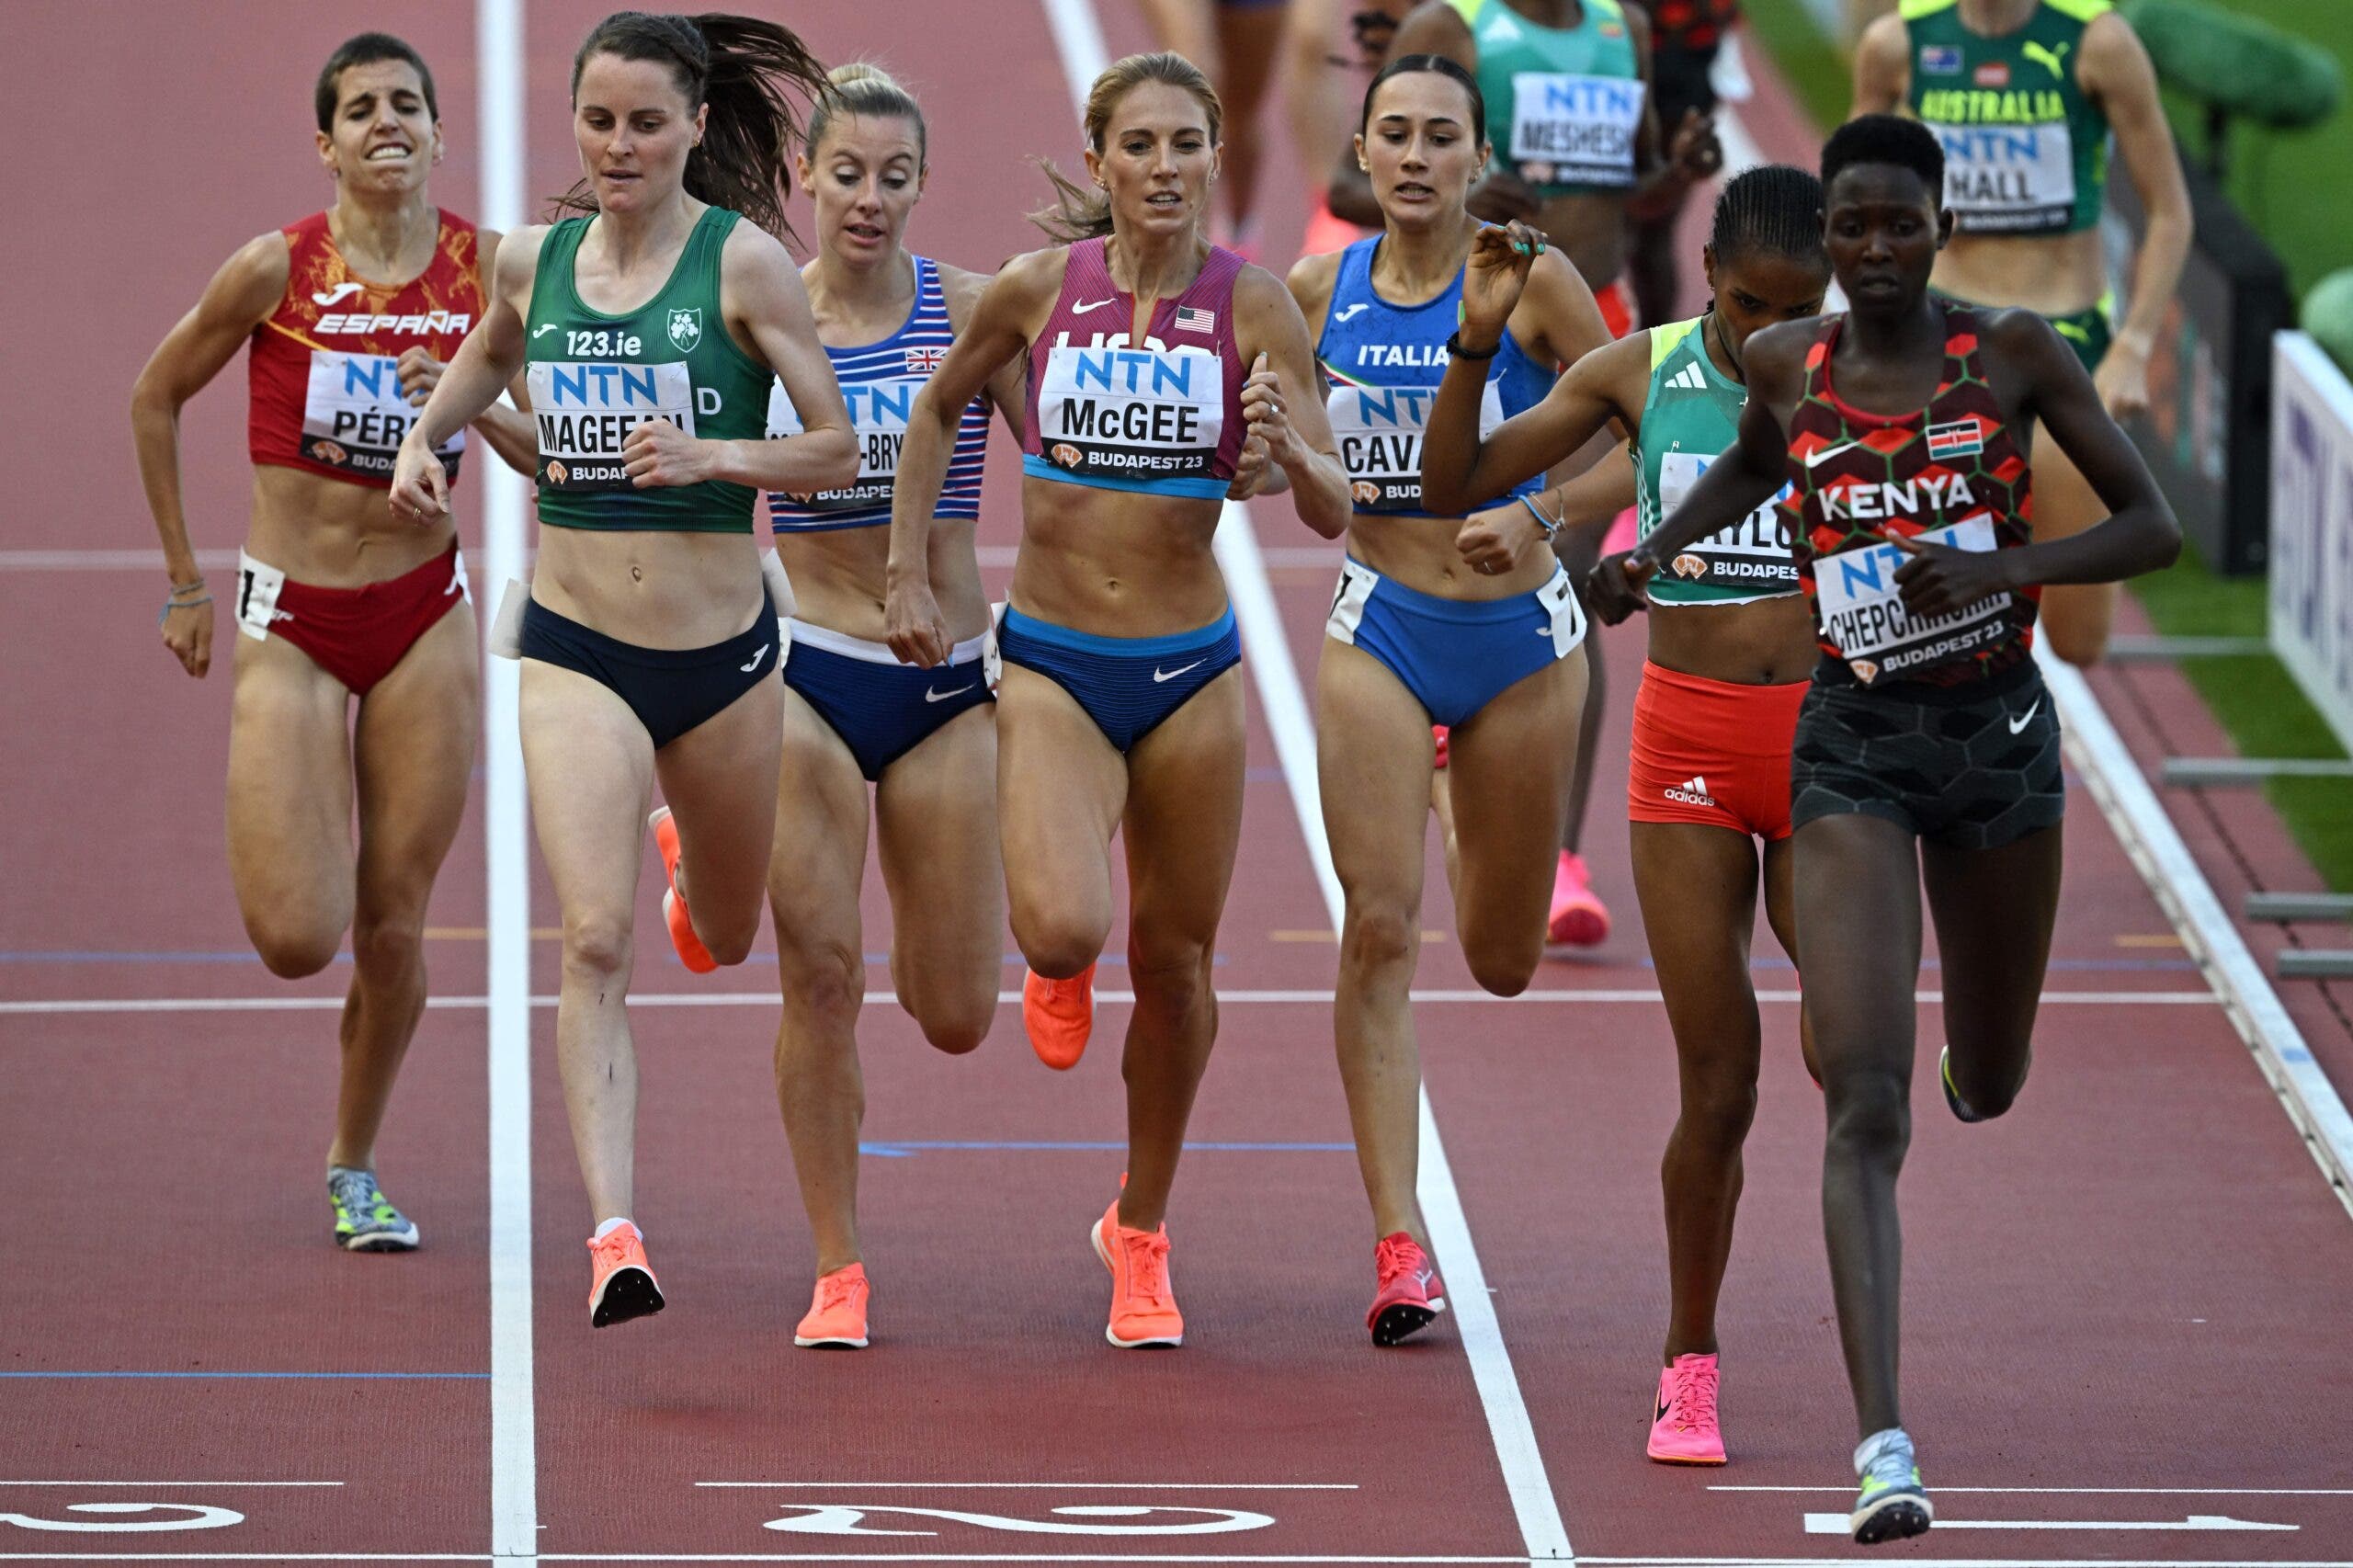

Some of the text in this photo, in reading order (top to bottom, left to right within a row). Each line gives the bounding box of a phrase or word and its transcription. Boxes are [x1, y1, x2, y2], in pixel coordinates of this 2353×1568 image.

[1546, 84, 1631, 111] NTN
[1920, 89, 2066, 123] AUSTRALIA
[1942, 129, 2040, 162] NTN
[1949, 170, 2035, 201] HALL
[313, 311, 471, 336] ESPAÑA
[566, 331, 642, 357] 123.ie
[1358, 345, 1450, 367] ITALIA
[345, 357, 427, 401] NT
[552, 365, 658, 407] NTN
[1075, 351, 1191, 398] NTN
[1062, 398, 1199, 443] McGEE
[1358, 389, 1440, 427] NT
[333, 406, 449, 449] PÉR
[539, 414, 684, 453] MAGEE
[1088, 451, 1204, 470] BUDAPEST 23
[1817, 473, 1976, 522] KENYA
[1713, 562, 1800, 580] BUDAPES
[1883, 619, 2004, 672] BUDAPEST 23
[1664, 788, 1715, 806] adidas
